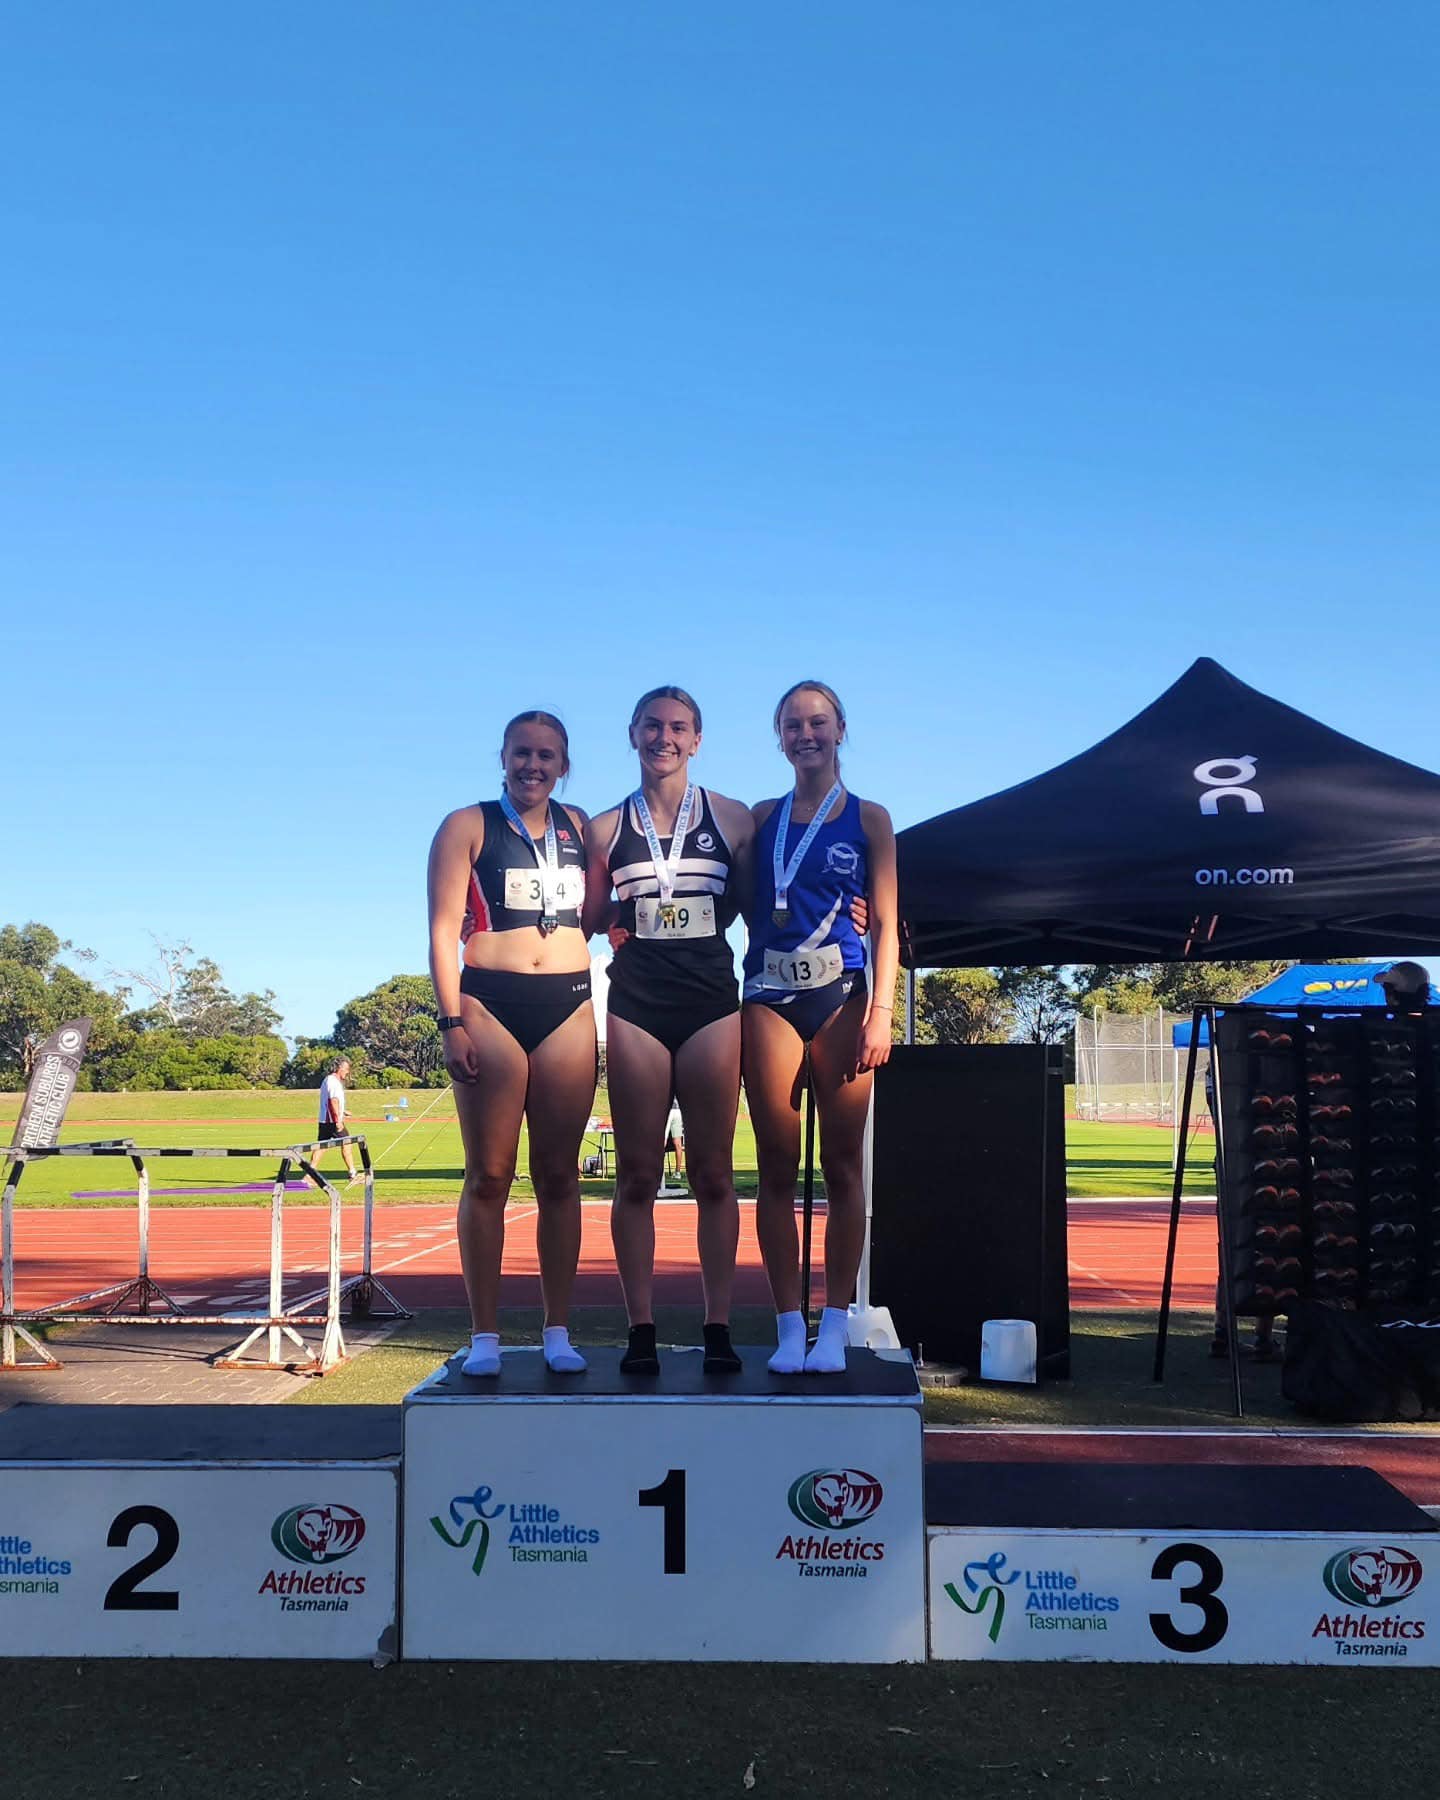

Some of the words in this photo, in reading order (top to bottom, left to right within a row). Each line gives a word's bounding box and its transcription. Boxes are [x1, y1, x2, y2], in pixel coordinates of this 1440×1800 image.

[1195, 868, 1294, 885] on.com
[790, 961, 812, 981] 13
[21, 1104, 45, 1148] ORTHERN
[34, 1055, 60, 1104] SUBURBS
[39, 1100, 63, 1147] ATHLETIC
[52, 1073, 70, 1100] CLUB
[510, 1504, 560, 1523] Little
[638, 1469, 686, 1574] 1
[508, 1525, 600, 1543] Athletics
[0, 1536, 32, 1555] ttle
[508, 1546, 588, 1562] Tasmania
[776, 1535, 885, 1560] Athletics
[104, 1505, 180, 1610] 2
[798, 1562, 868, 1577] Tasmania
[0, 1577, 59, 1593] smania
[258, 1570, 366, 1594] Athletics
[1025, 1571, 1077, 1590] Little
[280, 1597, 349, 1612] Tasmania
[1025, 1592, 1120, 1611] Athletics
[1149, 1543, 1229, 1653] 3
[1025, 1613, 1107, 1630] Tasmania
[1312, 1613, 1425, 1639] Athletics
[1335, 1640, 1407, 1656] Tasmania
